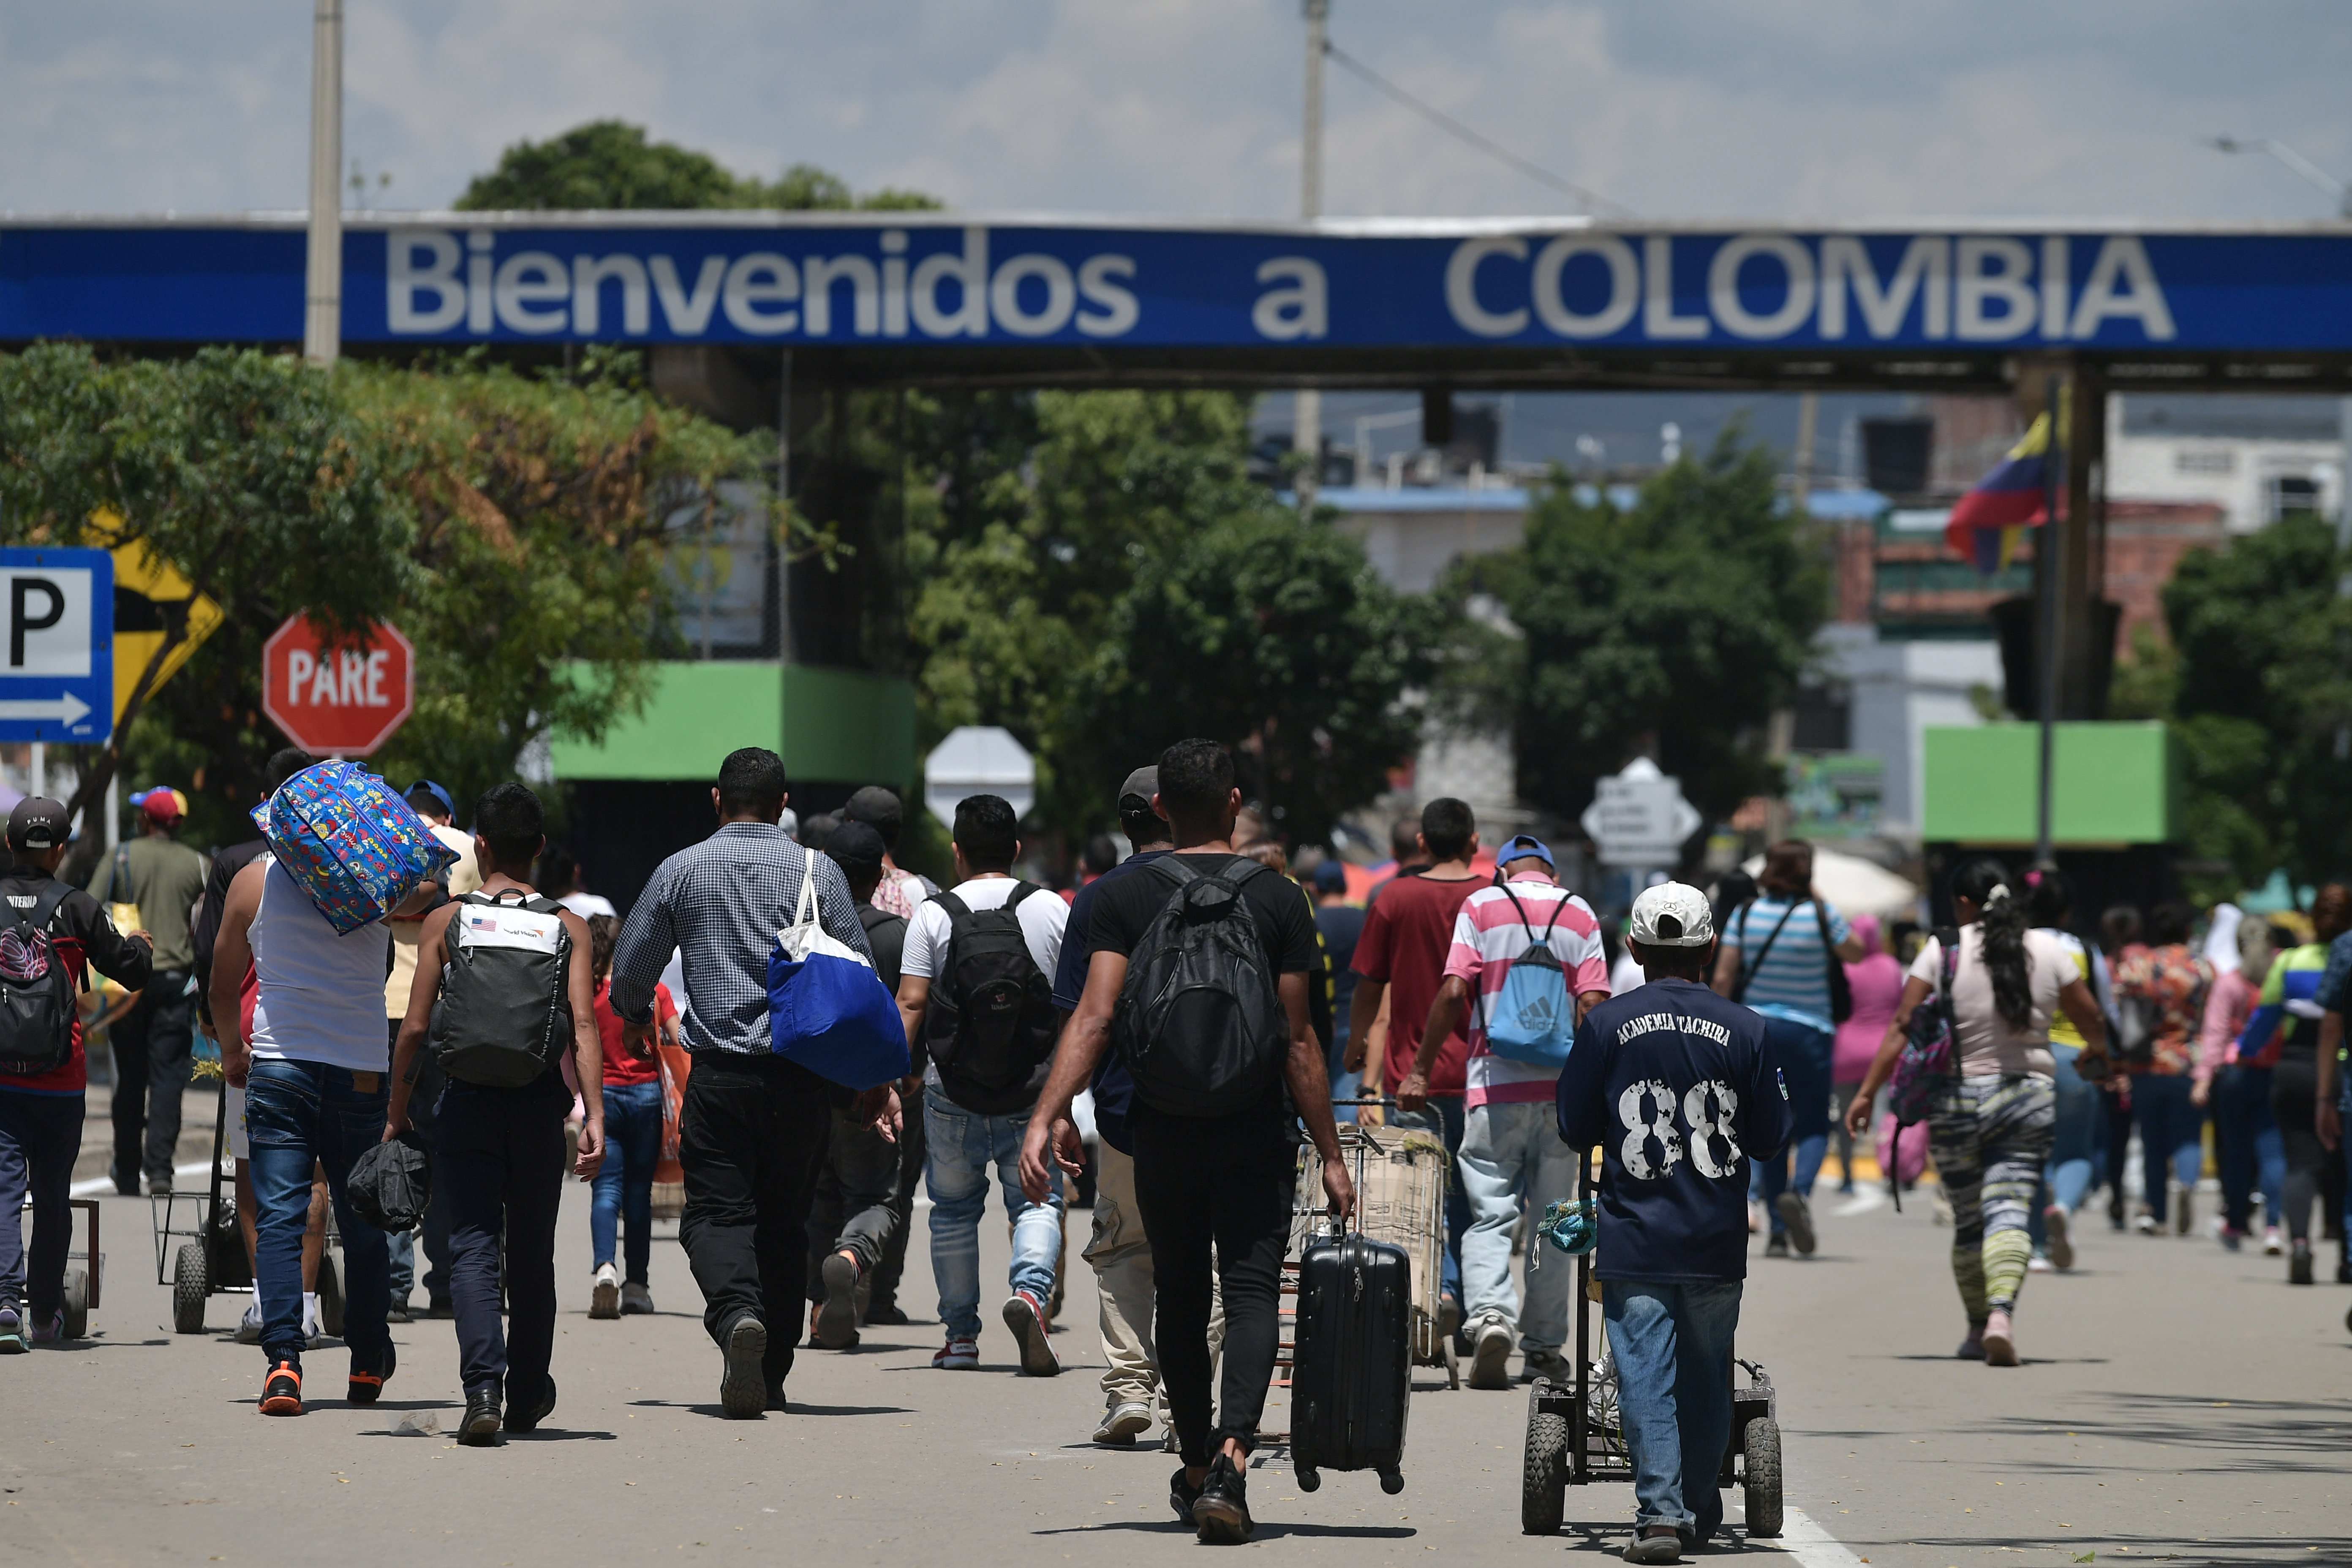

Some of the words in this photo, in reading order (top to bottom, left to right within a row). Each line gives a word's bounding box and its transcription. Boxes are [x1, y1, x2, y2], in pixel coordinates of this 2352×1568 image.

[387, 226, 1139, 337] Bienvenidos
[1252, 256, 1328, 339] a
[1445, 231, 2176, 341] COLOMBIA
[11, 577, 65, 666] P
[288, 649, 389, 707] PARE
[27, 816, 51, 825] PUMA
[1617, 1013, 1676, 1046] ACADEMIA
[1677, 1015, 1731, 1047] TACHIRA
[1619, 1079, 1742, 1180] 88
